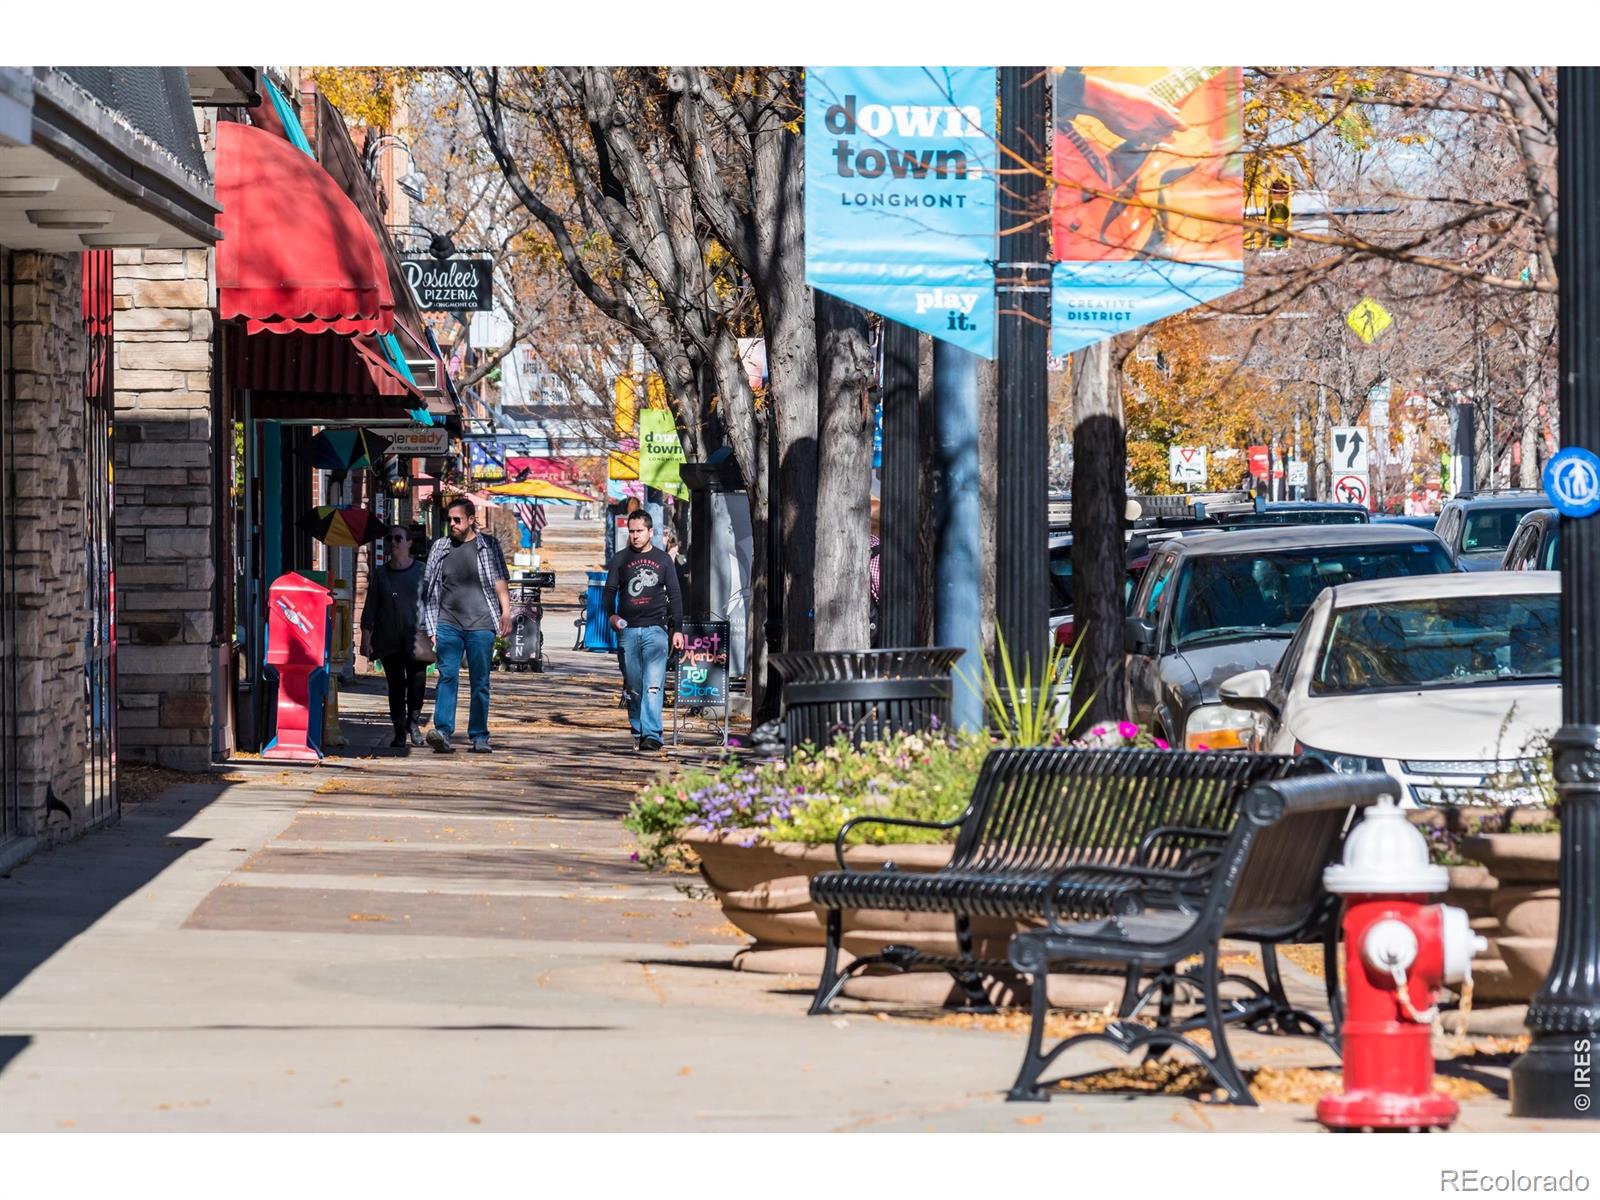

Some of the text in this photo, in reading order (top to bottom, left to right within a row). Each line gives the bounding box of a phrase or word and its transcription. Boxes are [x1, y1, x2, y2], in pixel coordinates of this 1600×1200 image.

[825, 95, 986, 137] down
[842, 192, 967, 208] LONGMONT
[401, 262, 479, 308] Rosalee's
[425, 290, 478, 300] PIZZERIA
[915, 291, 978, 314] play
[1068, 299, 1135, 308] CREATIVE
[947, 311, 976, 330] it.
[1068, 312, 1132, 321] DISTRICT
[1292, 473, 1306, 481] 25
[627, 559, 661, 569] CALIFORNIA
[515, 615, 525, 657] OPEN
[684, 633, 721, 650] Lost
[679, 648, 727, 666] Marbles
[683, 666, 708, 683] Toy
[681, 678, 720, 697] Store
